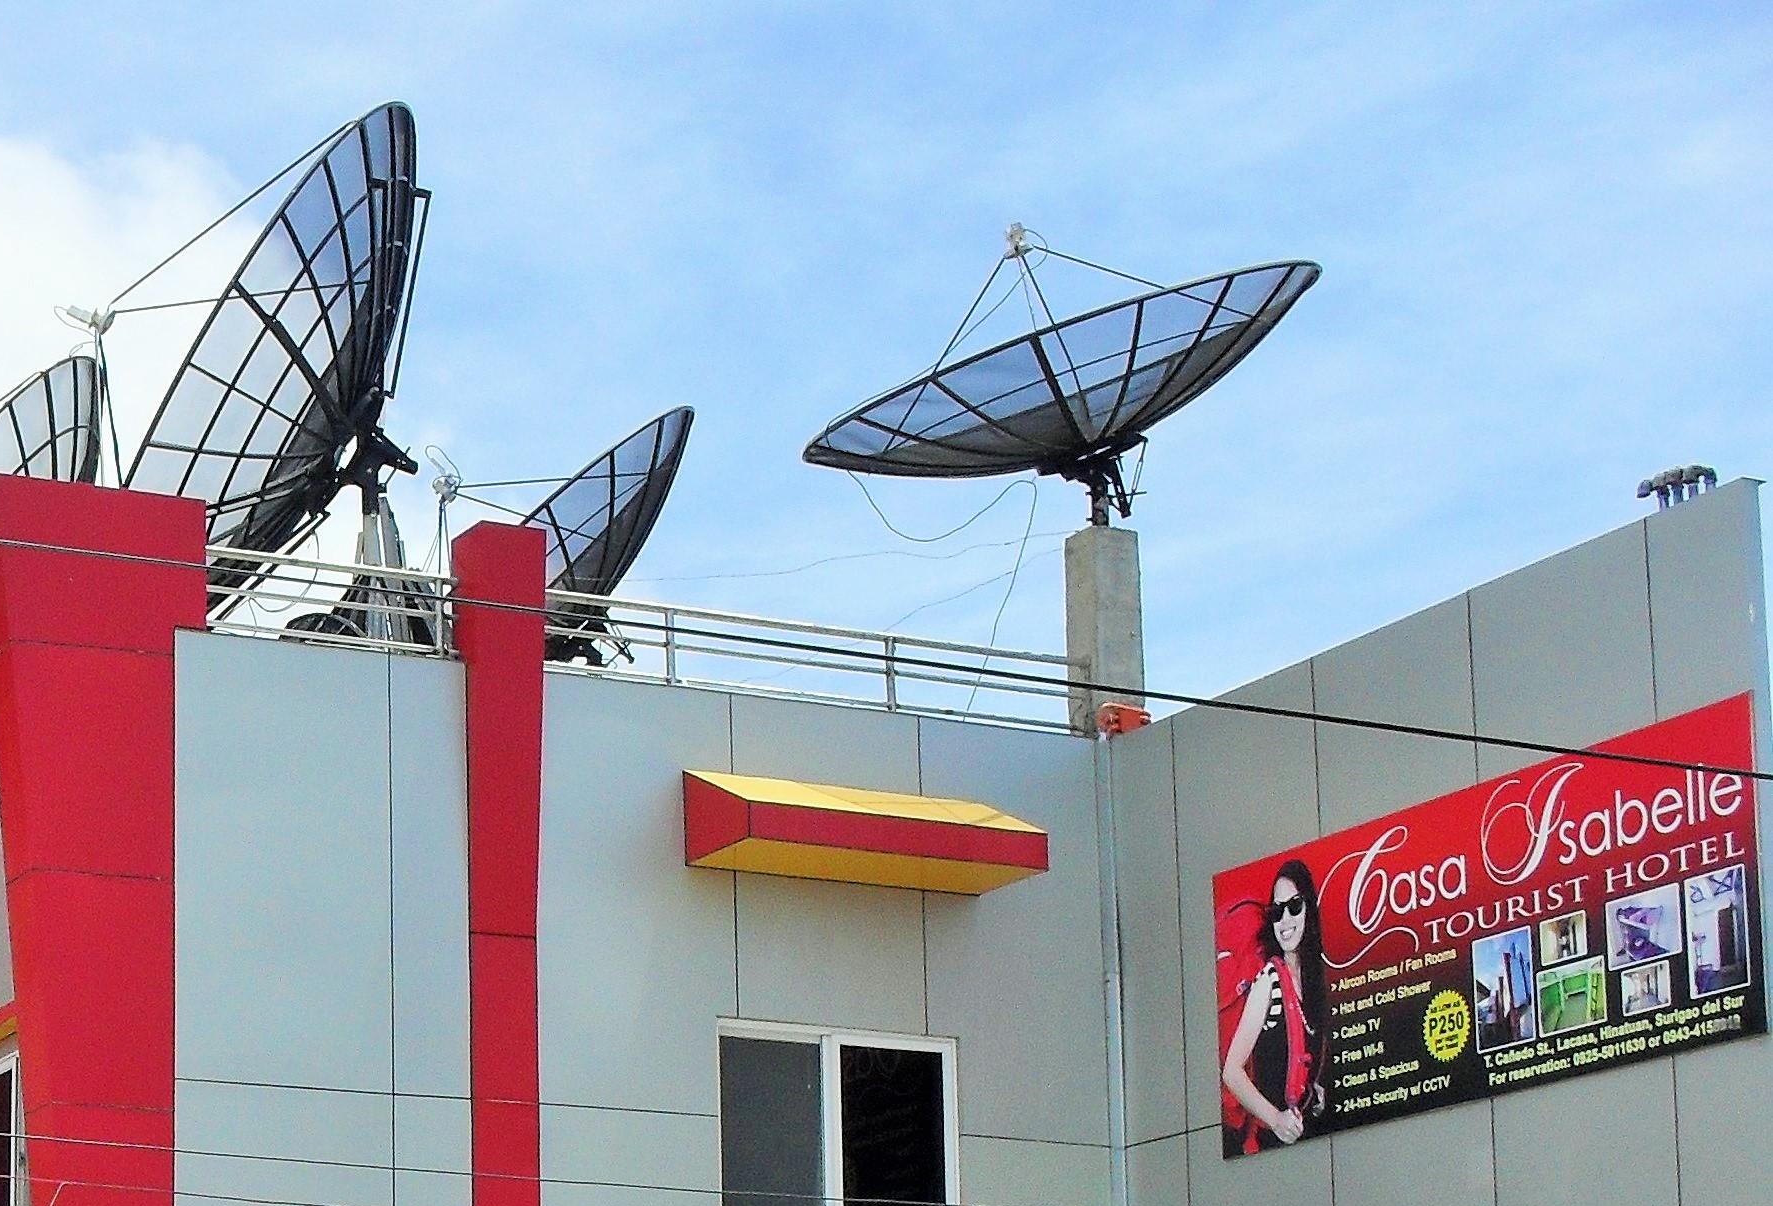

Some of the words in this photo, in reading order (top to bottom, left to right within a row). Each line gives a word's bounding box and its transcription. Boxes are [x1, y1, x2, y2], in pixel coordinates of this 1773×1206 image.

[1317, 825, 1467, 934] Casa
[1481, 762, 1742, 885] Isabelle
[1424, 876, 1589, 943] TOURIST
[1605, 832, 1745, 894] HOTEL
[1368, 965, 1397, 982] Rooms
[1424, 949, 1457, 965] Rooms
[1376, 988, 1395, 1006] Cold
[1655, 1006, 1700, 1027] Surigao
[1723, 995, 1745, 1011] Sur
[1340, 1023, 1366, 1039] Cable
[1367, 1017, 1381, 1031] TV
[1429, 1011, 1464, 1037] P250
[1341, 1049, 1362, 1064] Free
[1342, 1072, 1368, 1088] Clean
[1378, 1059, 1420, 1080] Spacious
[1488, 1071, 1506, 1086] For
[1372, 1086, 1408, 1105] Security
[1422, 1075, 1451, 1093] CCTV
